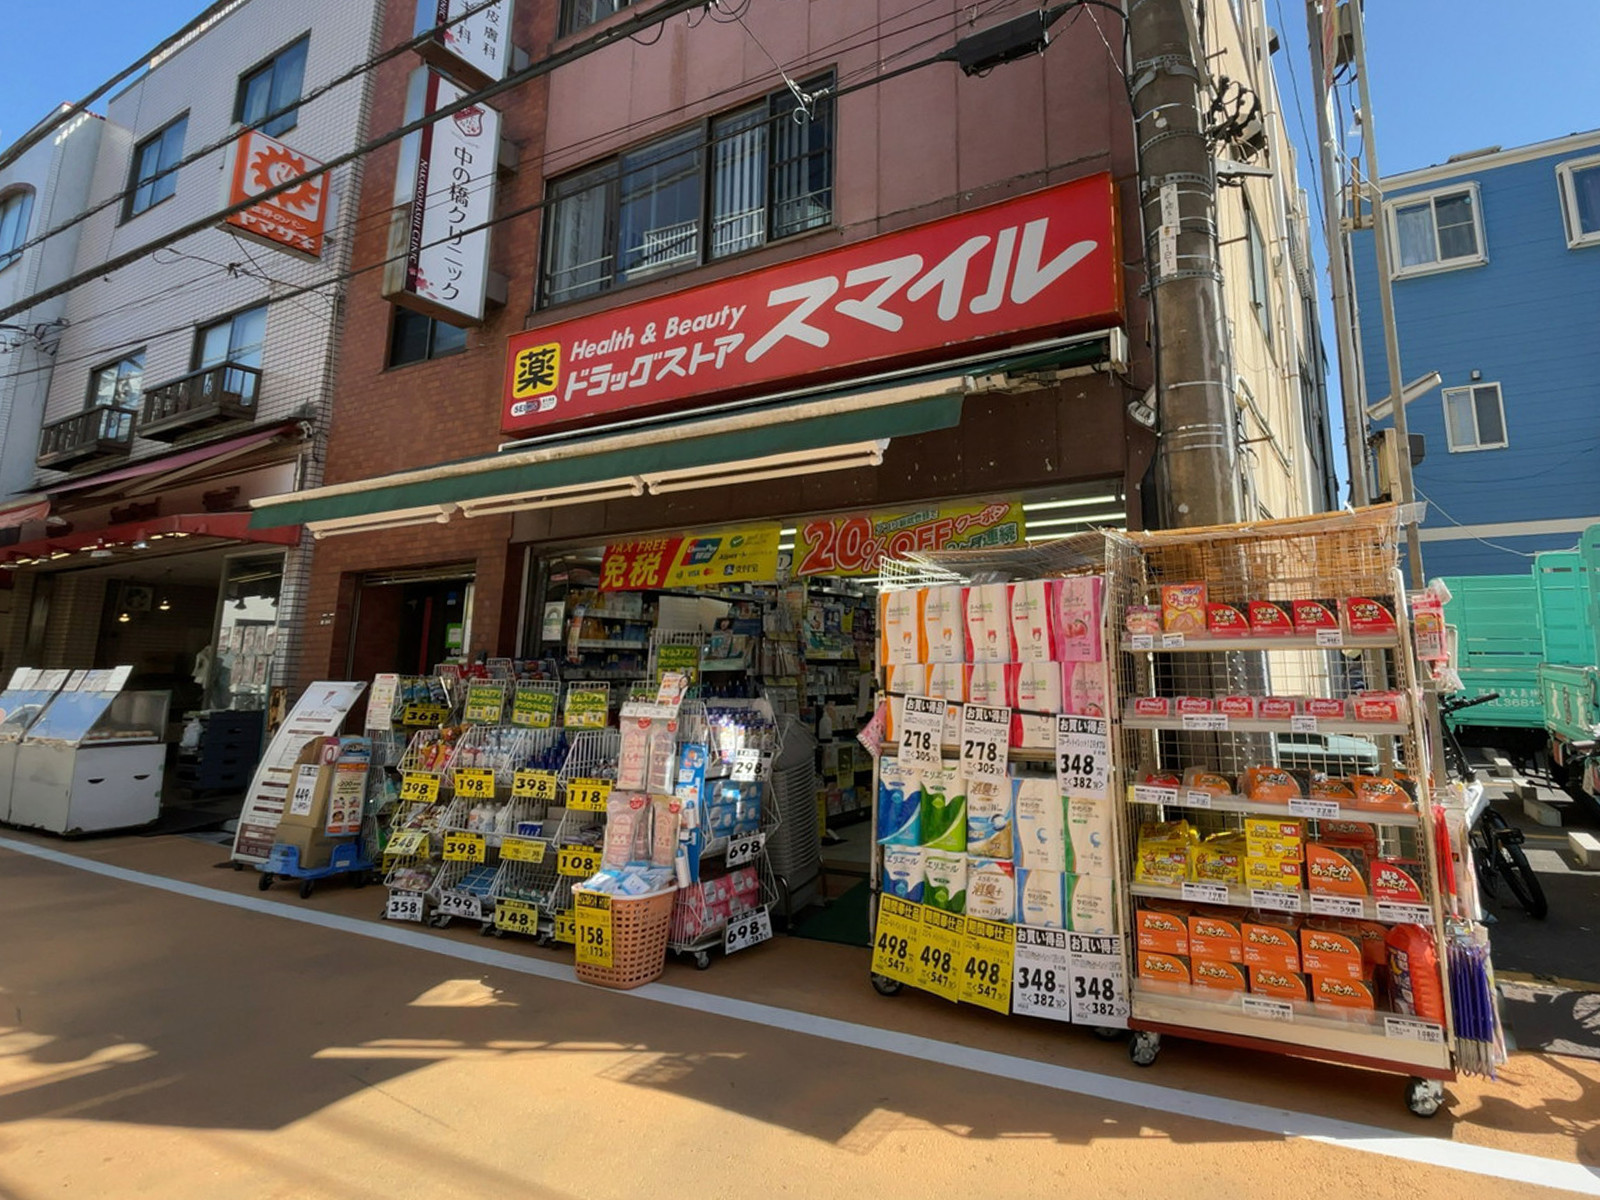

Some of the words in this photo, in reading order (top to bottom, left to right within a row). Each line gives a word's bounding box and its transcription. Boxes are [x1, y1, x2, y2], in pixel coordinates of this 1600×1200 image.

[414, 158, 429, 231] NAKANOHASHI
[240, 211, 315, 249] ヤマザキ
[442, 146, 473, 300] 中の橋クリニック
[408, 231, 420, 264] CLINIC
[745, 217, 1098, 363] スマイル
[569, 327, 634, 361] Health
[640, 322, 657, 344] &
[664, 304, 747, 340] Beauty
[516, 348, 556, 392] 薬
[564, 332, 745, 401] ドラッグストア
[955, 503, 1010, 534] クーポン
[637, 539, 668, 551] FREE
[600, 551, 664, 588] 免税
[407, 711, 440, 721] 368
[904, 729, 931, 750] 278
[916, 751, 930, 761] 305
[964, 740, 997, 761] 278
[735, 762, 762, 774] 298
[978, 763, 995, 774] 305
[1061, 754, 1094, 775] 348
[403, 782, 429, 795] 398
[460, 780, 483, 791] 198
[516, 778, 547, 791] 398
[1073, 777, 1092, 788] 382
[570, 790, 600, 803] 118
[446, 842, 476, 855] 398
[729, 841, 760, 859] 698
[562, 855, 593, 870] 108
[887, 855, 918, 865] エリエール
[926, 861, 959, 873] エリエール
[1311, 863, 1351, 879] あったか
[1377, 878, 1408, 889] あったか
[391, 901, 417, 913] 358
[443, 895, 473, 910] 299
[499, 910, 528, 925] 148
[1144, 919, 1172, 931] あったか
[580, 925, 604, 945] 158
[728, 921, 759, 944] 698
[1195, 925, 1225, 937] あったか
[878, 933, 907, 959] 498
[1249, 933, 1280, 945] あったか
[1310, 939, 1342, 952] あったか
[888, 957, 905, 972] 547
[920, 945, 951, 973] 498
[1145, 960, 1173, 972] あったか
[965, 957, 1000, 985] 498
[1199, 966, 1227, 978] あったか
[931, 972, 948, 986] 547
[1019, 967, 1056, 992] 348
[1257, 973, 1287, 986] あったか
[977, 984, 997, 999] 547
[1075, 976, 1114, 1001] 348
[1321, 983, 1353, 996] あったか
[1034, 994, 1054, 1007] 382
[1092, 1003, 1114, 1016] 382
